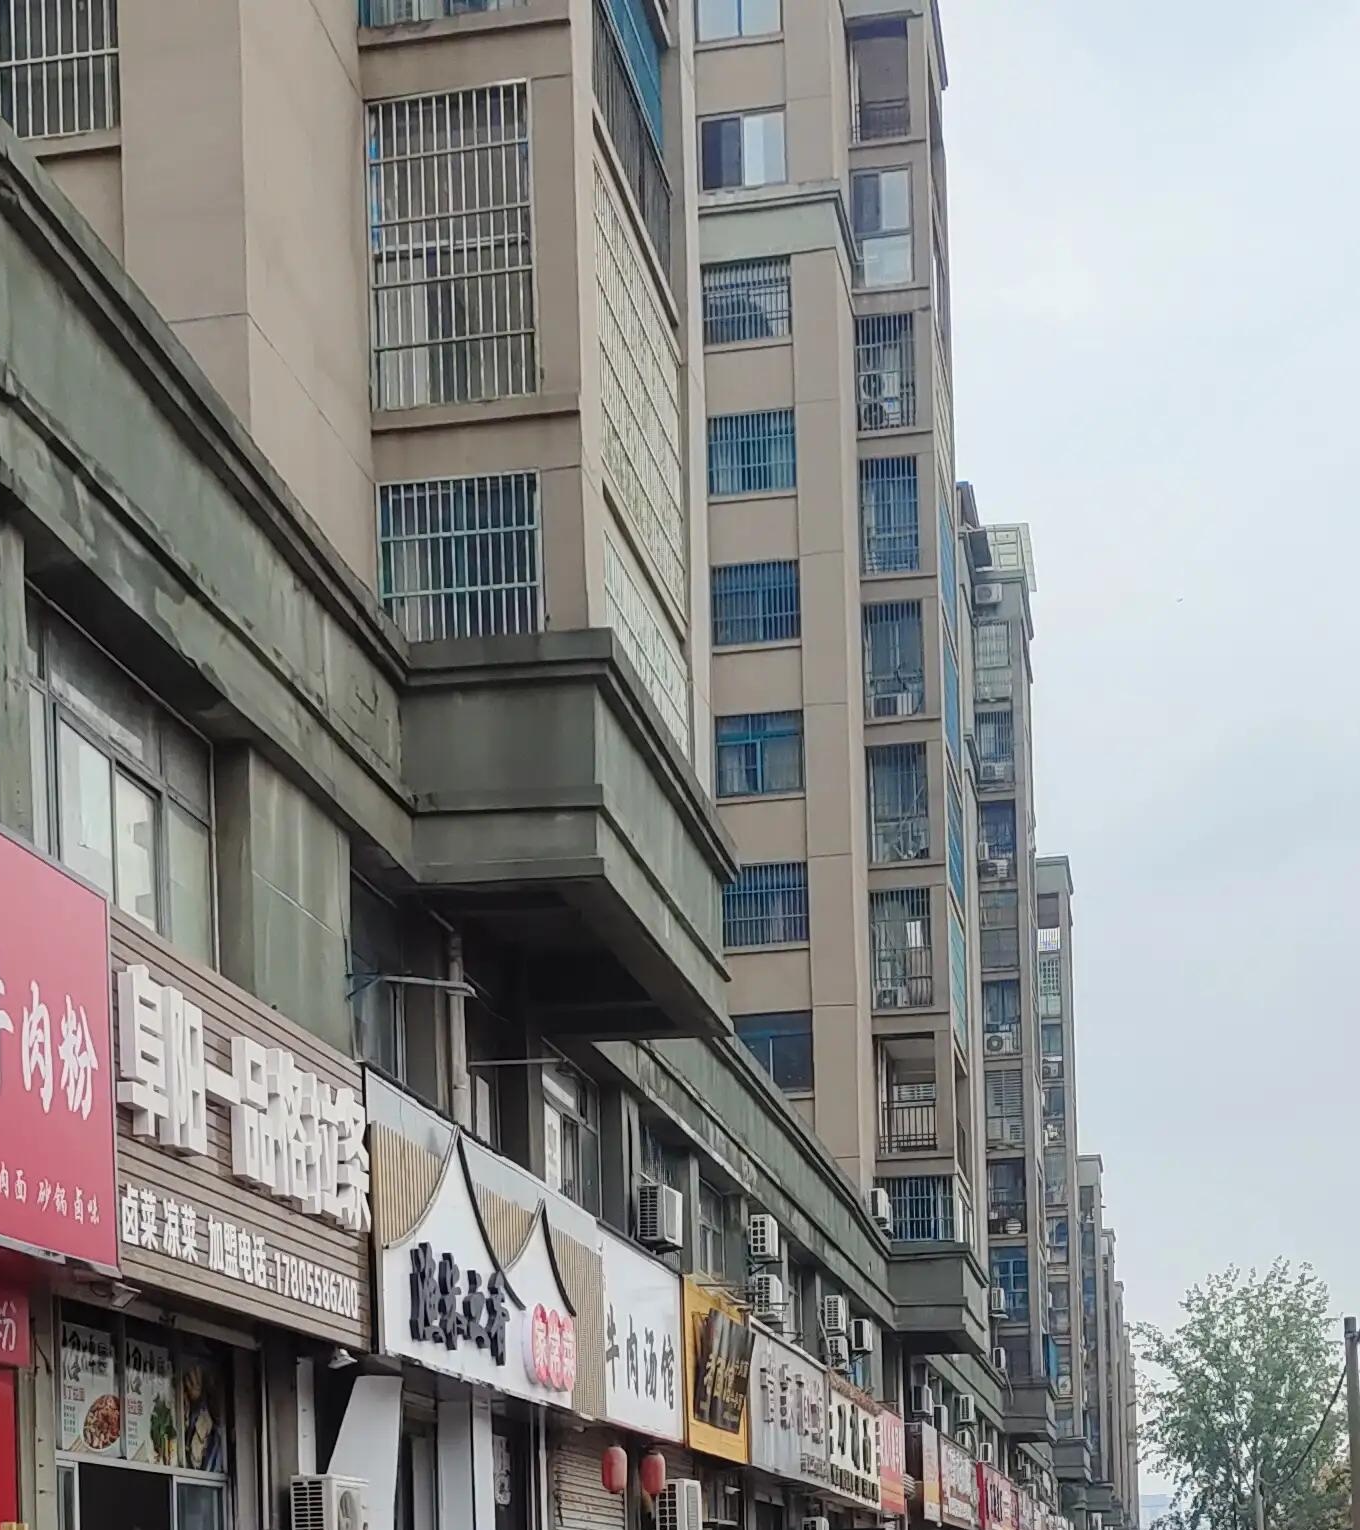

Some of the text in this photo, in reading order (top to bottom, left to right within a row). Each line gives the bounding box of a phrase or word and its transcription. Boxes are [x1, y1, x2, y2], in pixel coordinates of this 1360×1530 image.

[116, 964, 372, 1233] 阜阳一品格拉条
[121, 1183, 160, 1251] 卤菜
[162, 1198, 199, 1264] 凉菜
[605, 1301, 675, 1411] 牛肉汤馆
